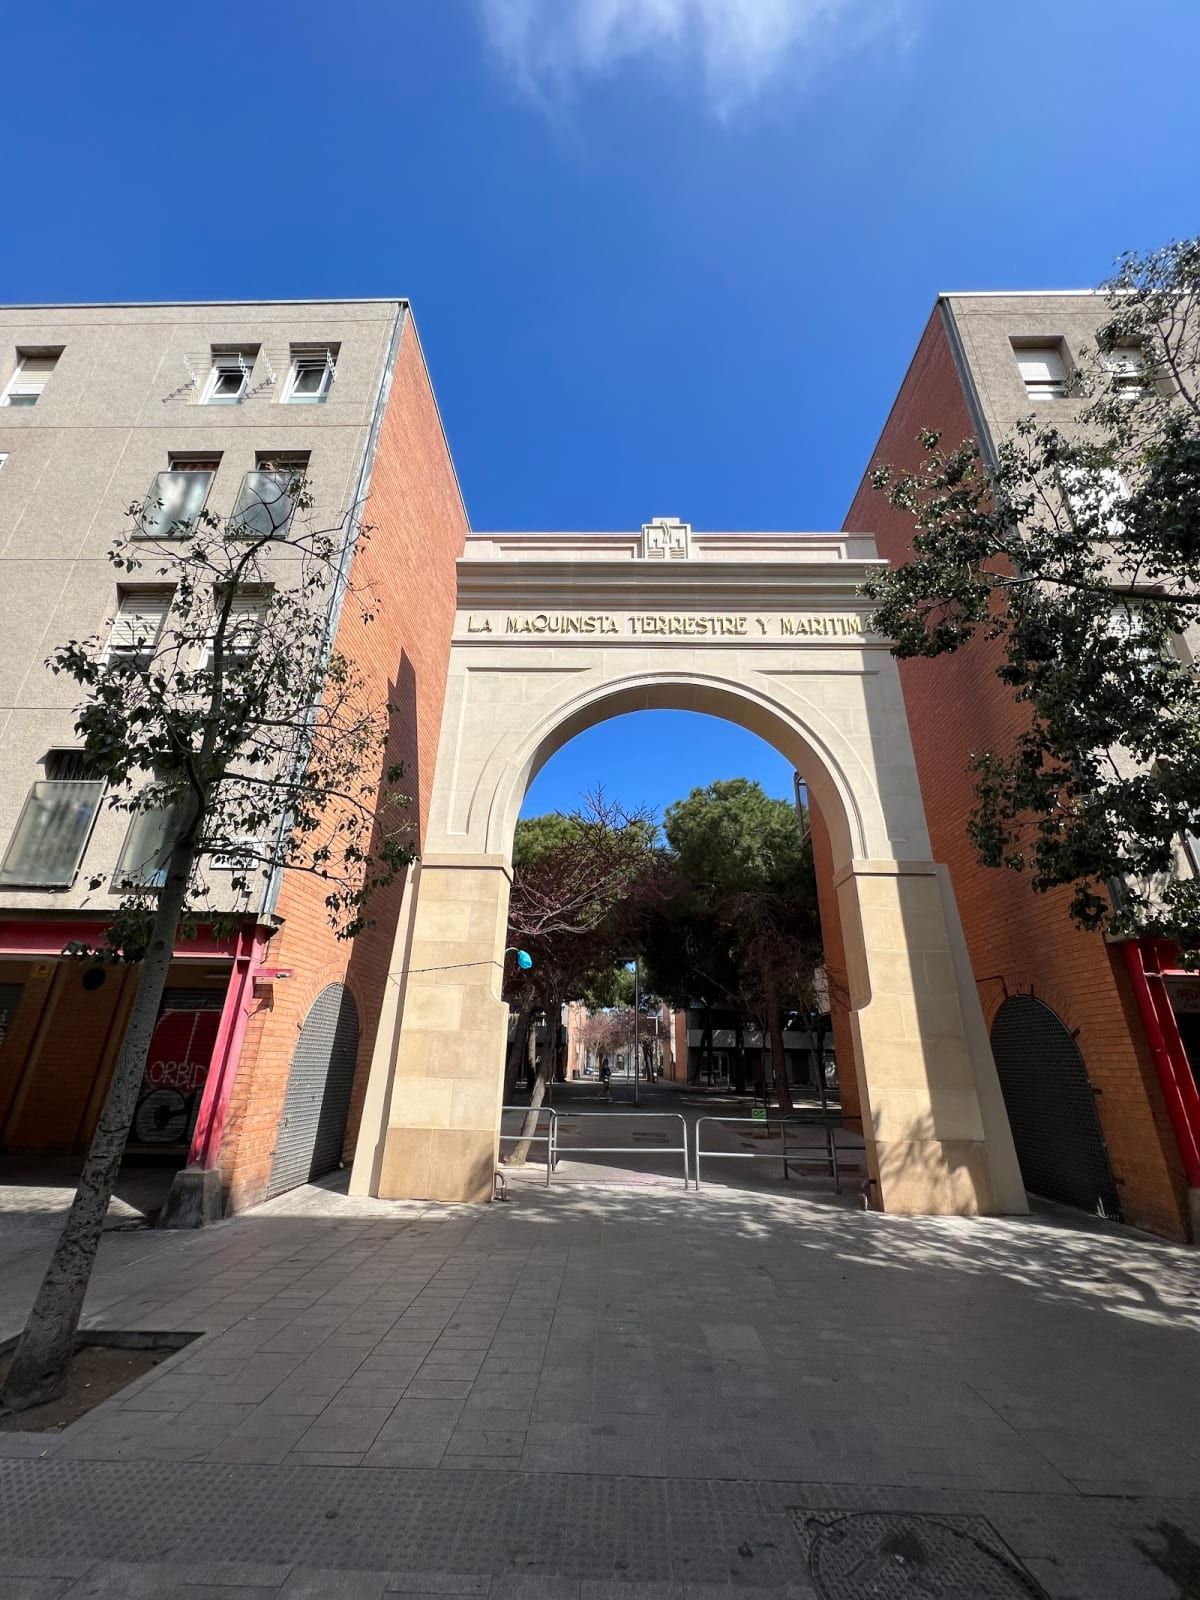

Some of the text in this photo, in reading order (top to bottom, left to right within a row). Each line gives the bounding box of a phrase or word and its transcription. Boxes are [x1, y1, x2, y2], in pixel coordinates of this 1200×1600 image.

[467, 615, 492, 633] LA
[505, 614, 619, 634] MAQUINISTA
[628, 616, 747, 635] TERRESTRE
[755, 615, 771, 634] Y
